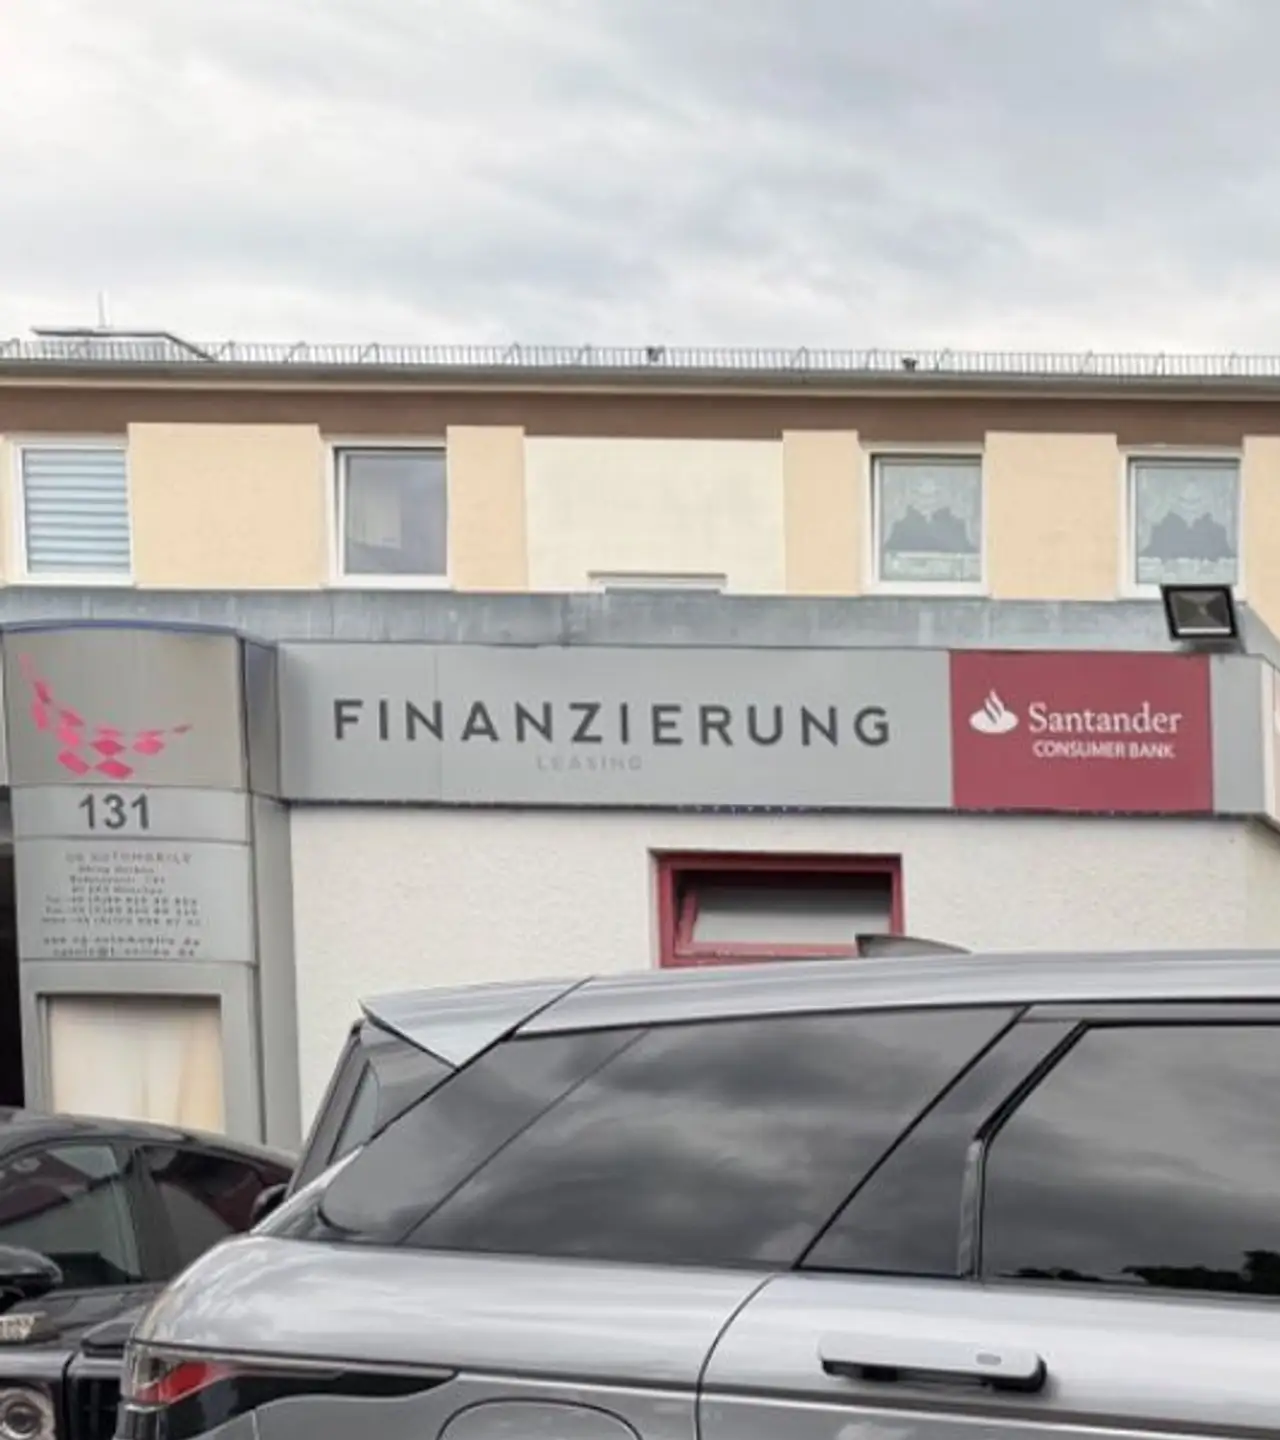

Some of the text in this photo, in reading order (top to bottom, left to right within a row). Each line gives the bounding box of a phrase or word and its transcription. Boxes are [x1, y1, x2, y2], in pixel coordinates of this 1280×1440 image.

[333, 698, 890, 747] FINANZIERUNG
[1028, 700, 1183, 734] Santander
[1032, 739, 1176, 758] CONSUMER BANK
[78, 793, 151, 831] 131
